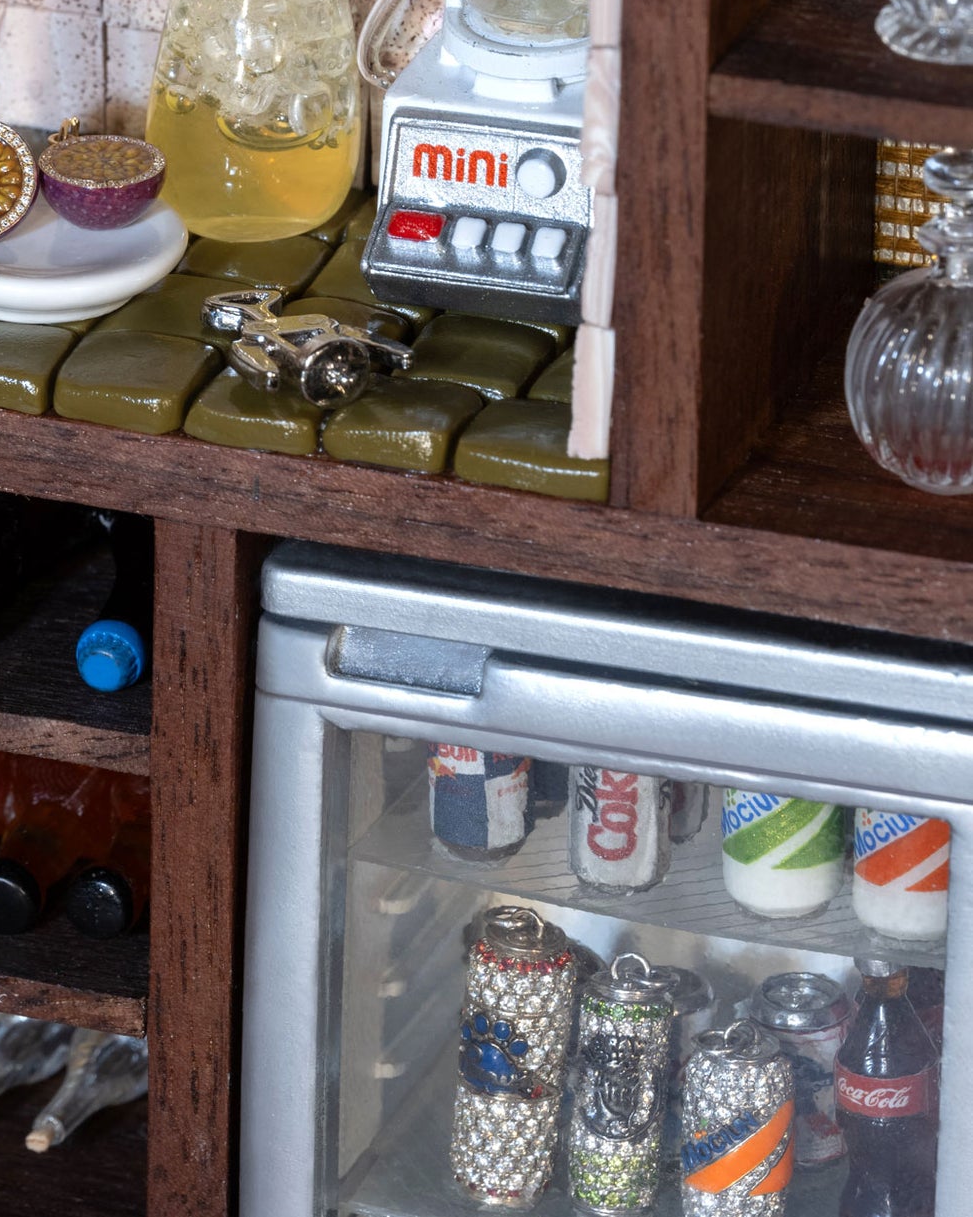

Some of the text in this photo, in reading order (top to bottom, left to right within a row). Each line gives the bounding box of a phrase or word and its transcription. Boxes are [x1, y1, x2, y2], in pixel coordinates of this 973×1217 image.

[412, 142, 509, 188] mini
[587, 769, 639, 861] Cok
[838, 1077, 912, 1109] Coca-Cola
